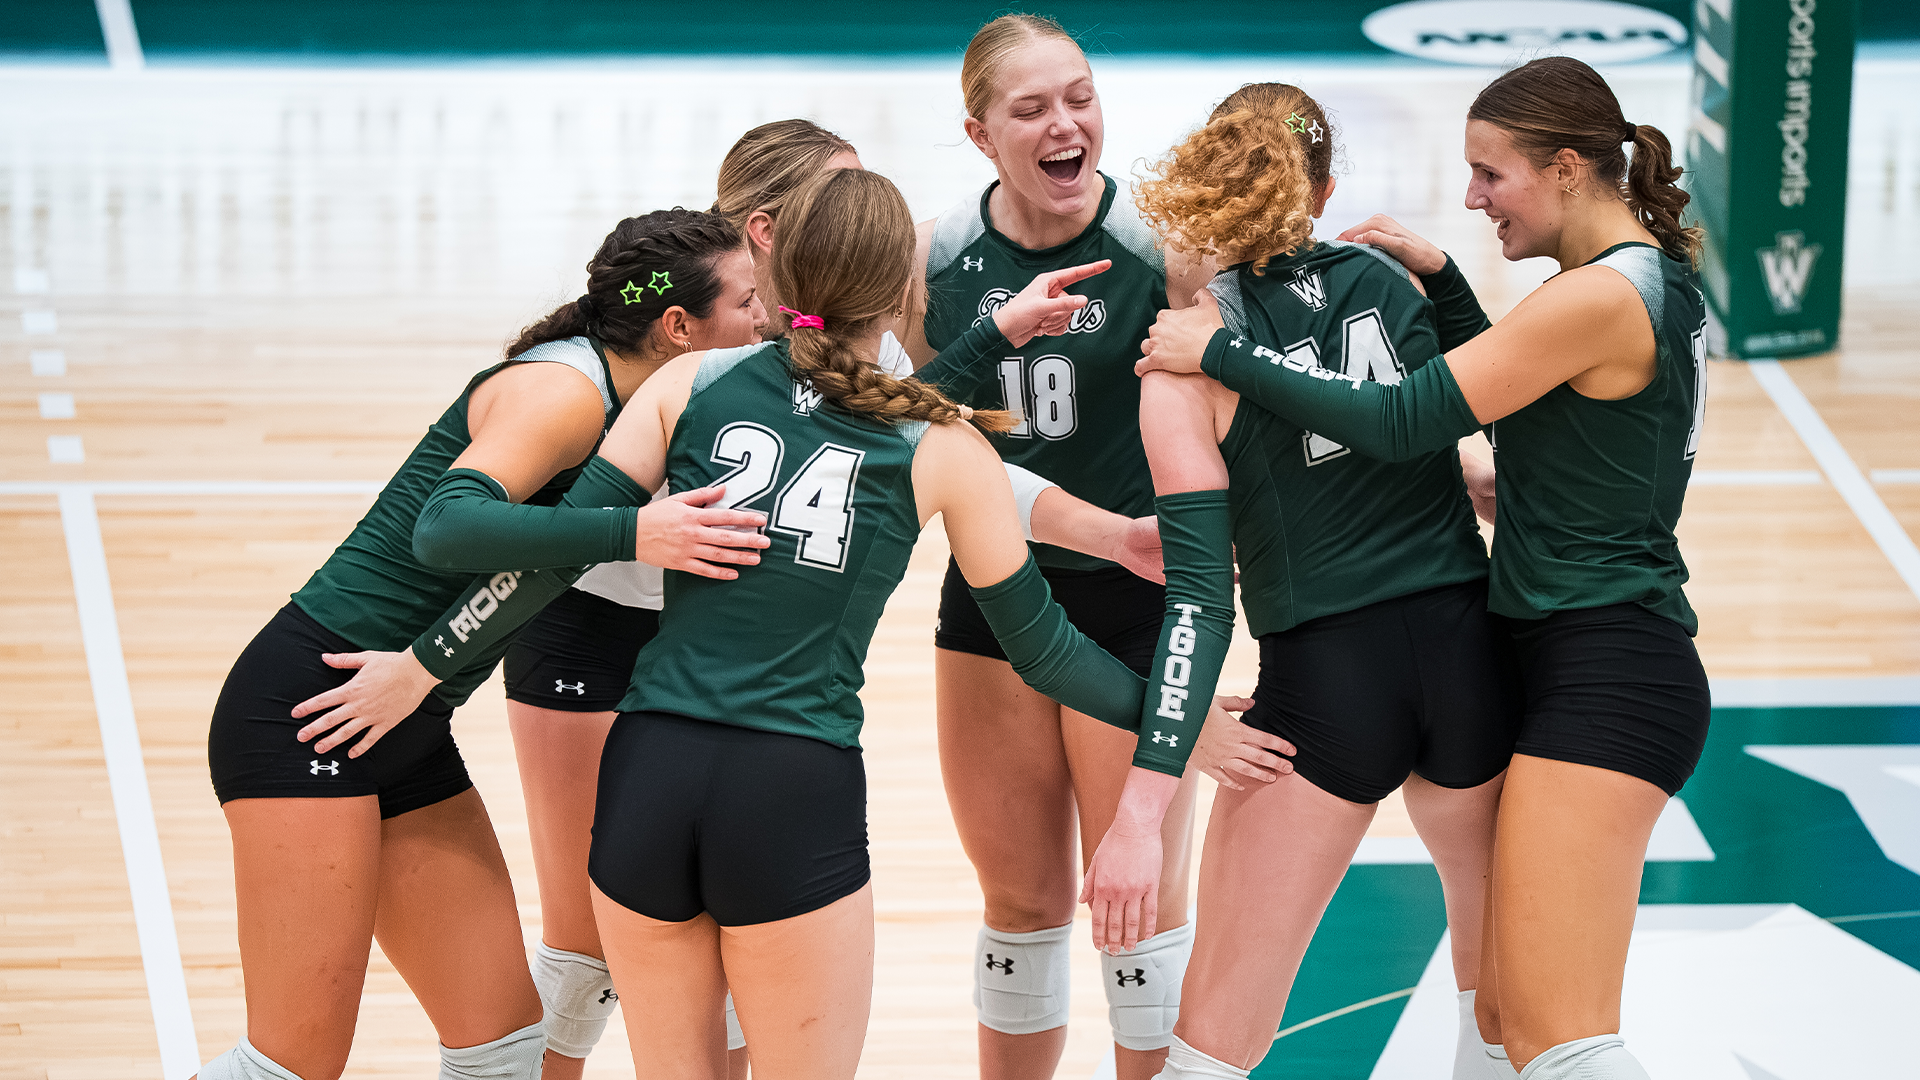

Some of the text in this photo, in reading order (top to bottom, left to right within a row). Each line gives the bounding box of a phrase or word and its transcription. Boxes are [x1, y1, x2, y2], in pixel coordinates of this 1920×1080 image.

[1777, 80, 1812, 207] imports
[997, 354, 1078, 441] 18
[710, 421, 866, 574] 24
[448, 568, 524, 643] GOE
